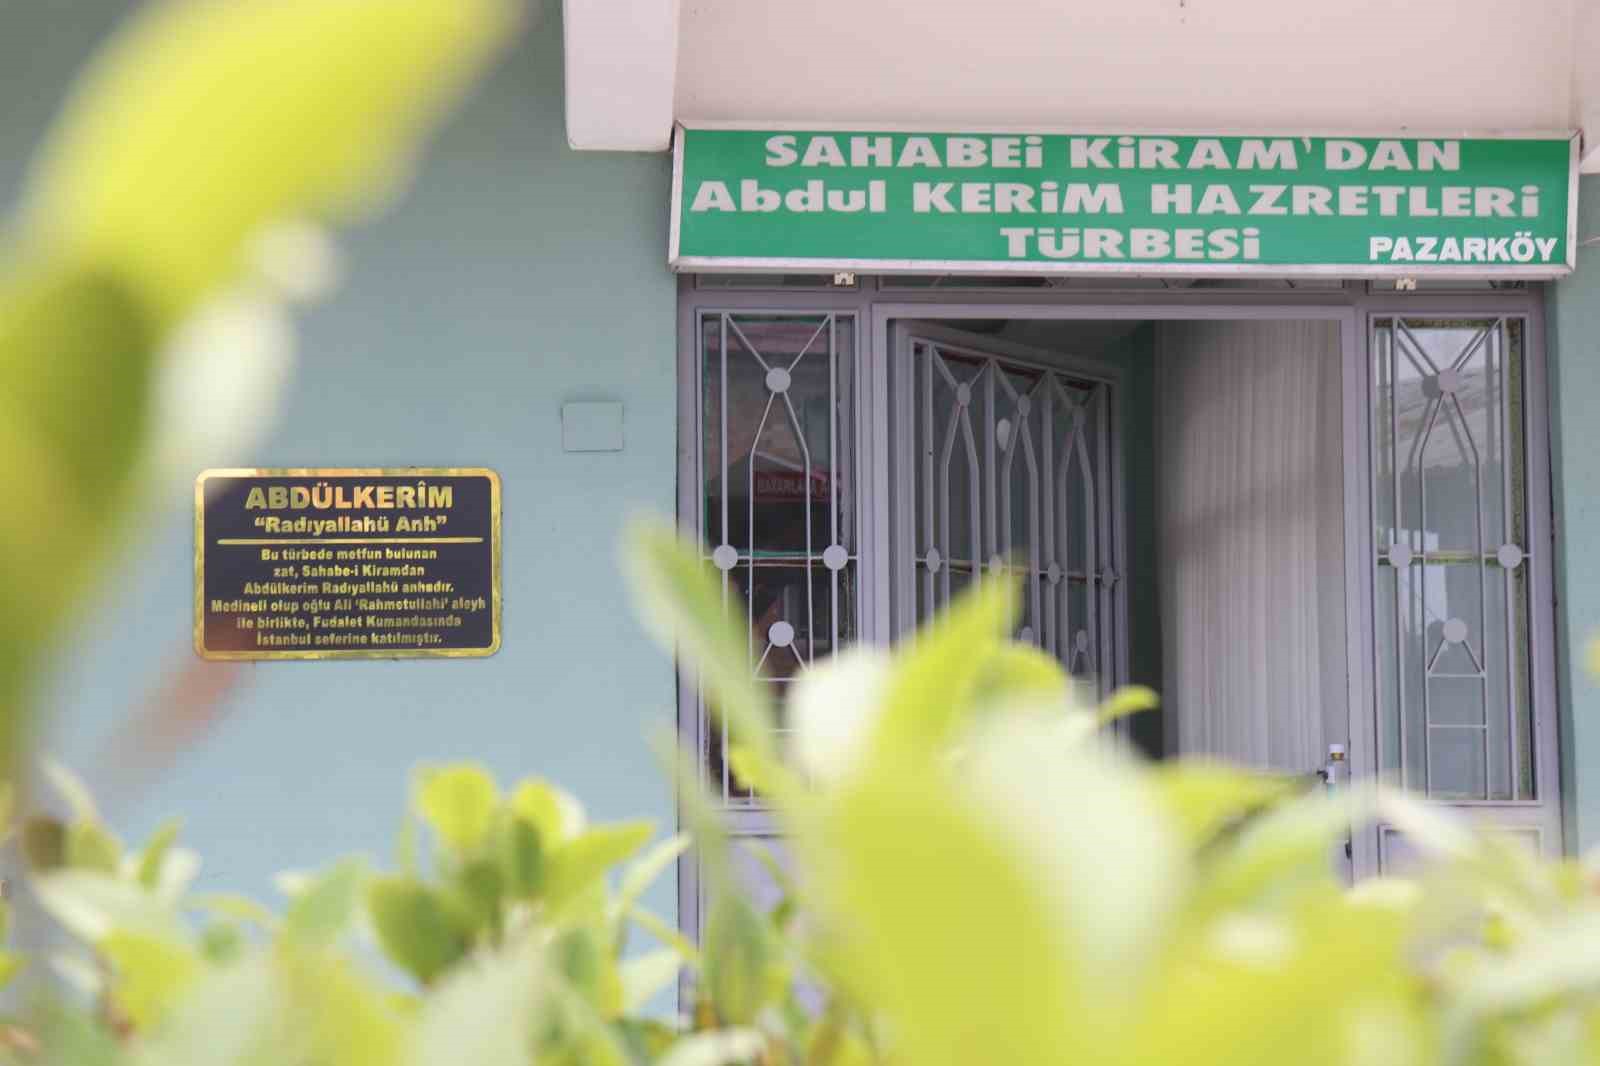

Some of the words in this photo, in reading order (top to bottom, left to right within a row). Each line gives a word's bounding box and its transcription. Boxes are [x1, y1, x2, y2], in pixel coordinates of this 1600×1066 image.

[690, 179, 887, 213] Abdul
[1368, 231, 1559, 263] PAZARKÖY
[245, 480, 454, 509] ABDÜLKERÎM
[260, 548, 279, 561] Bu
[282, 548, 334, 561] türbede
